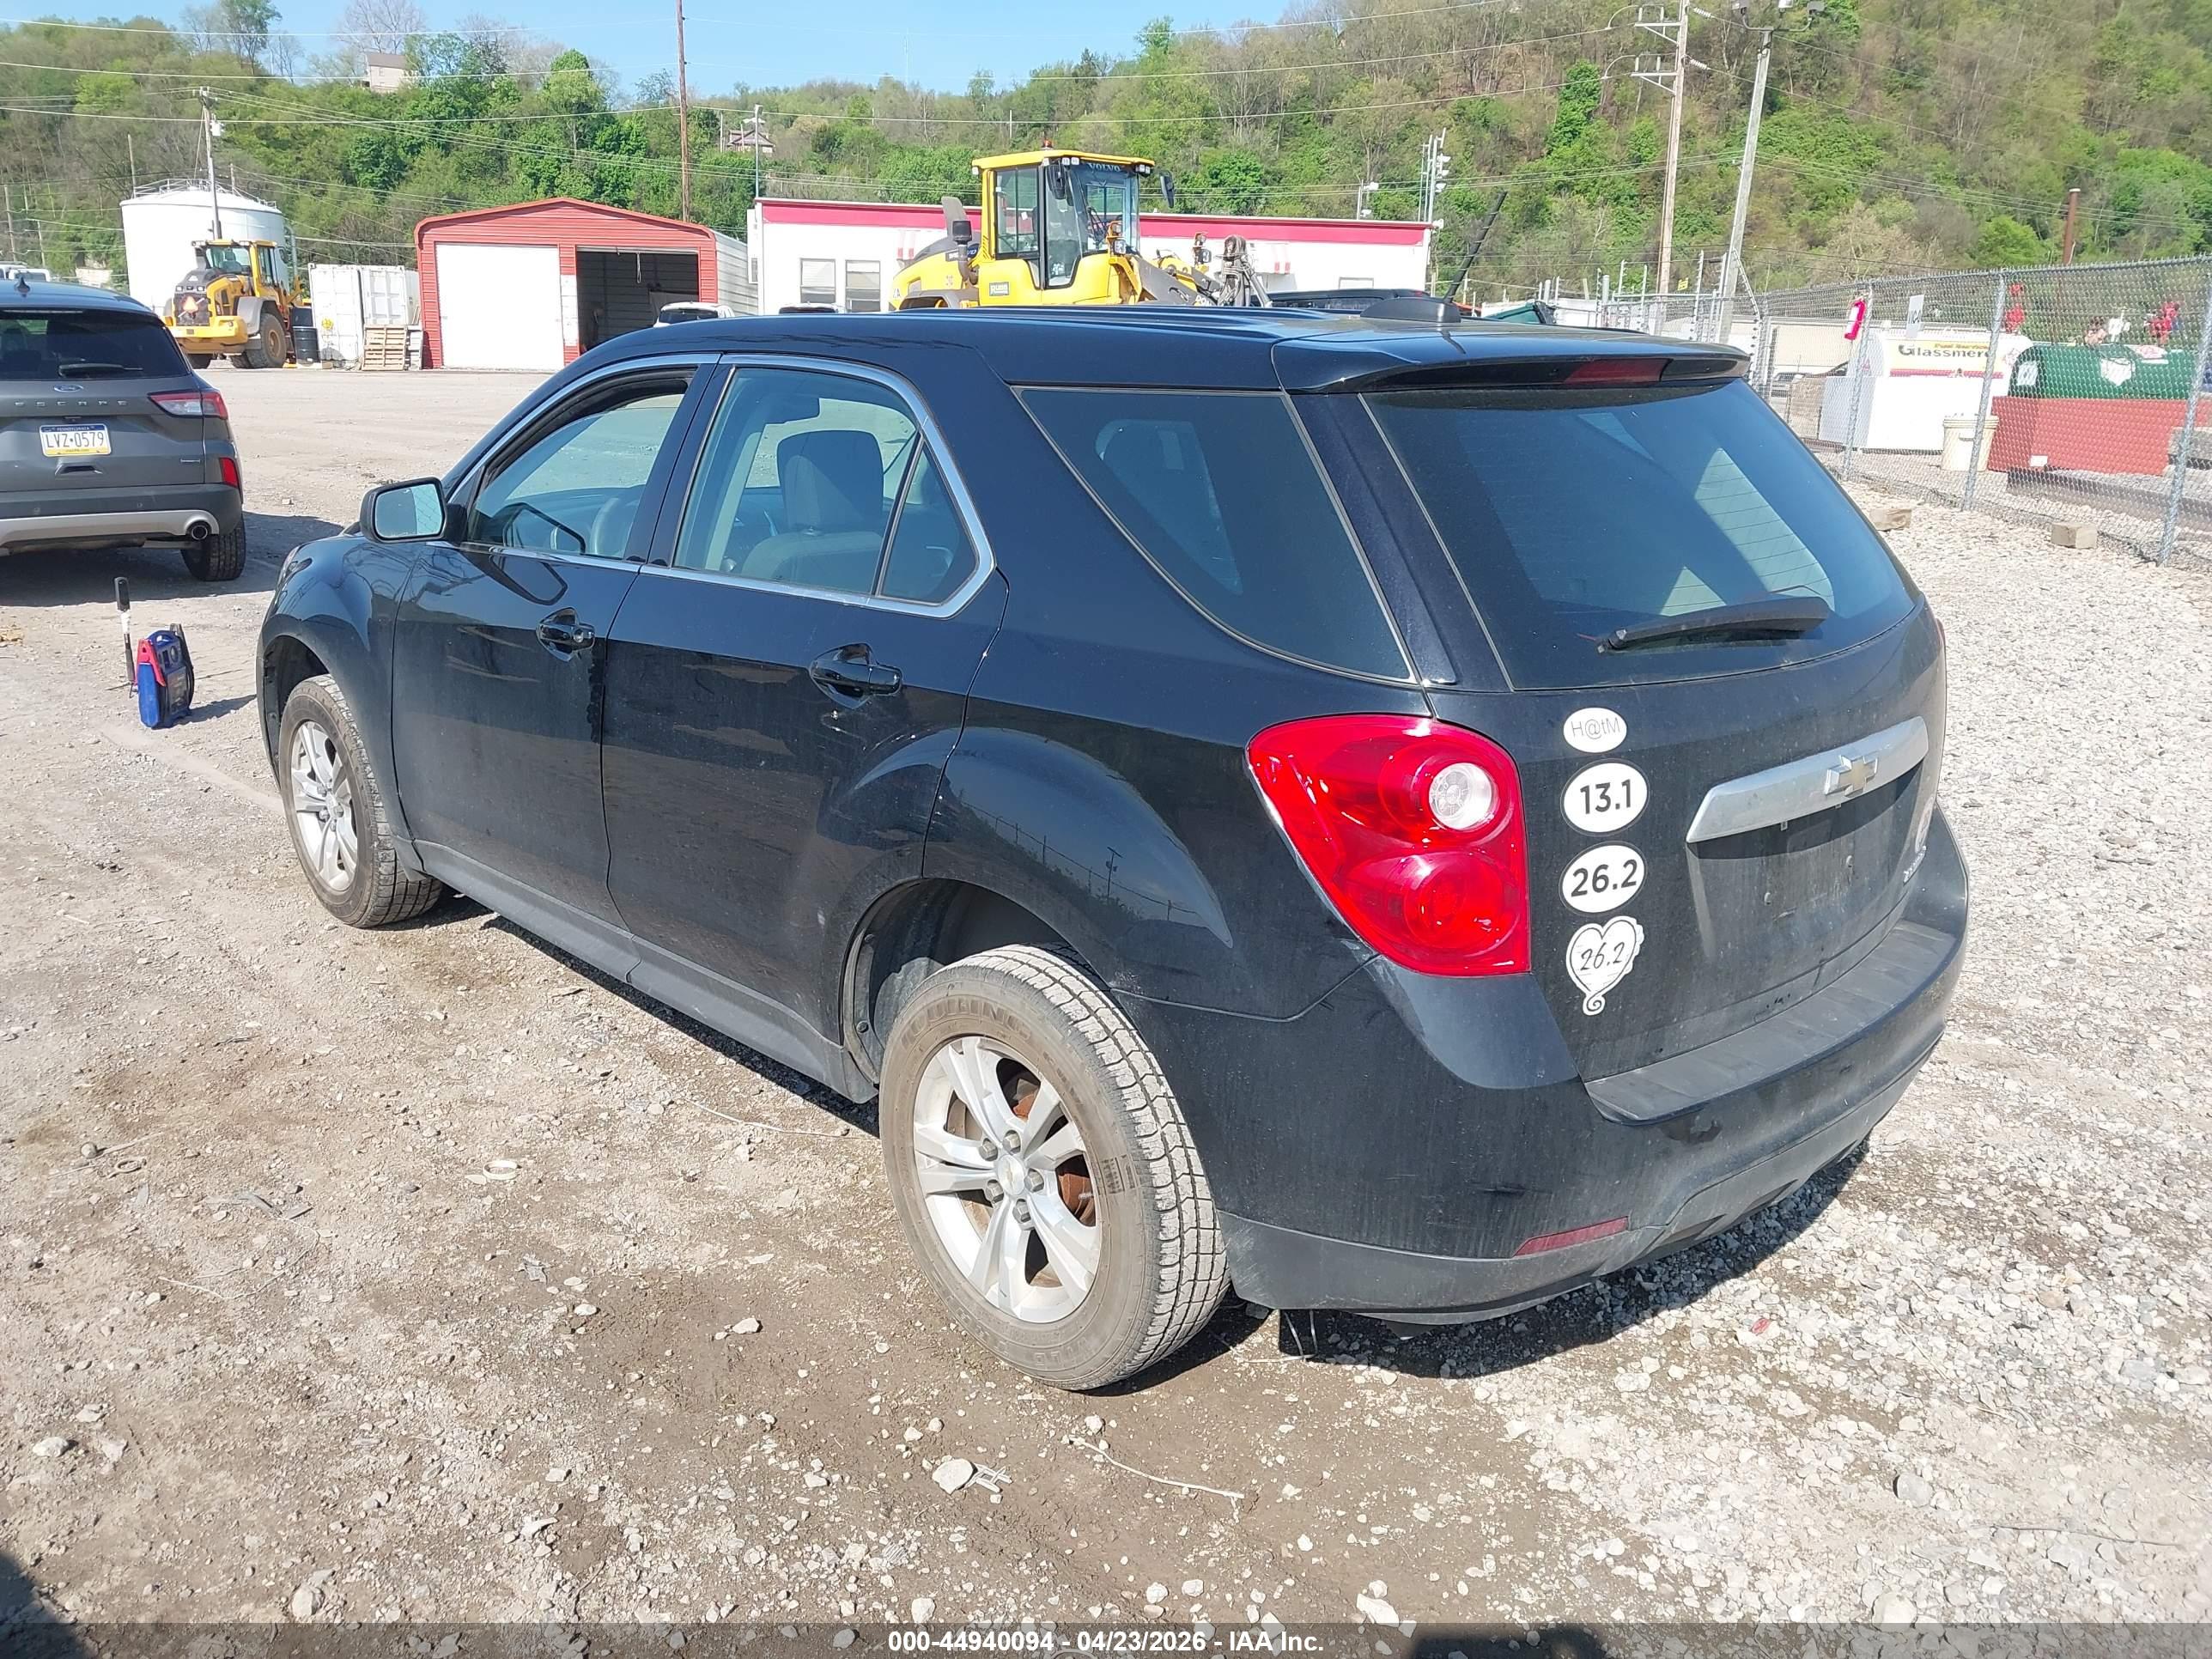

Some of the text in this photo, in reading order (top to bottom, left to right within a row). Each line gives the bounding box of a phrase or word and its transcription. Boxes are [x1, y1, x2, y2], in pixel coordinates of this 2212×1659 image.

[1088, 162, 1121, 172] VOLVO
[1580, 779, 1631, 814] 13.1
[1571, 859, 1638, 897] 26.2
[1580, 942, 1625, 971] 26.2
